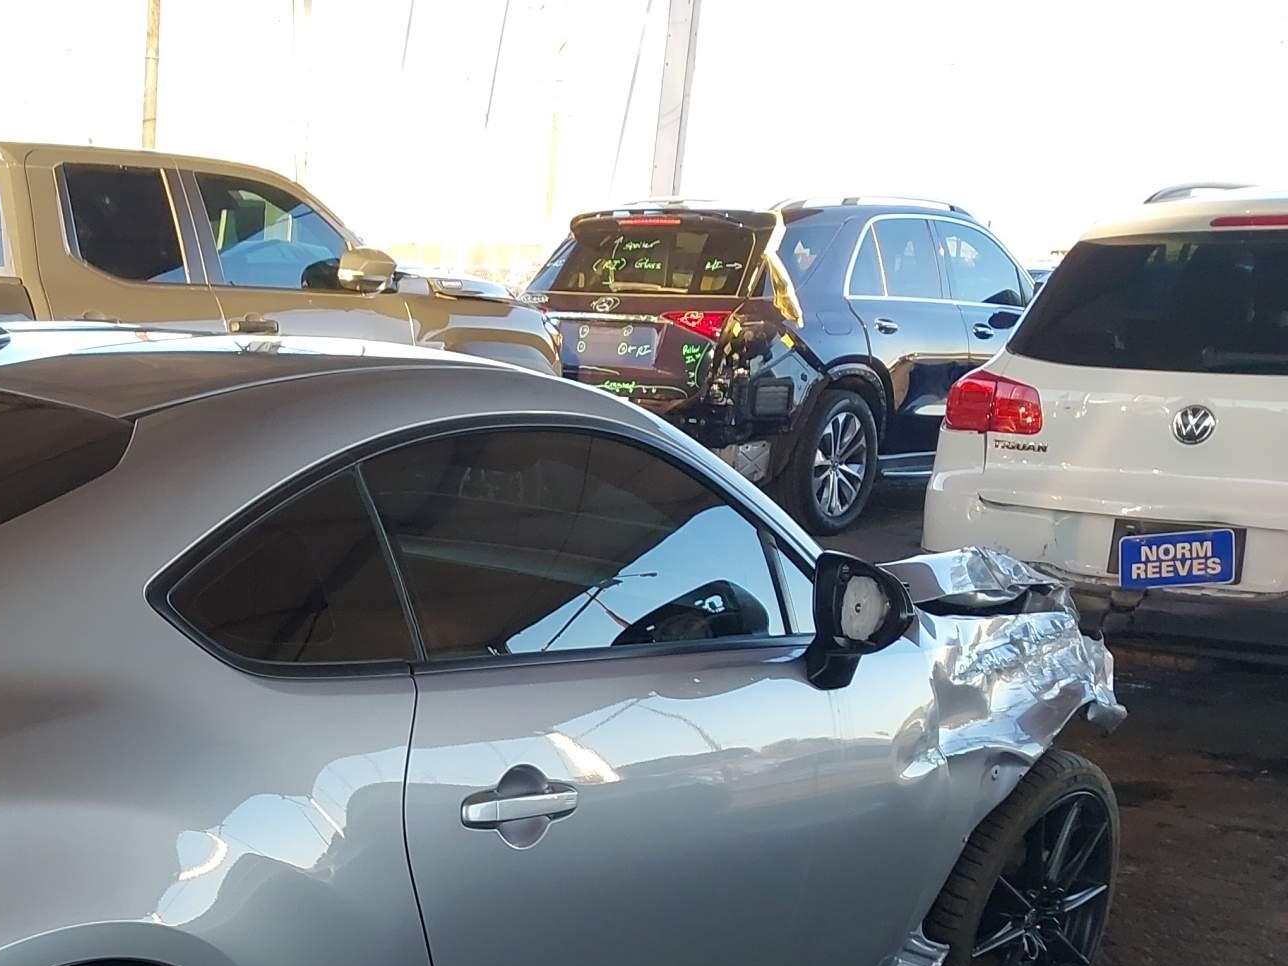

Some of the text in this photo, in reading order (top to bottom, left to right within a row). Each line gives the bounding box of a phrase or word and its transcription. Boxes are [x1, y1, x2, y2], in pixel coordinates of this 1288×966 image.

[993, 439, 1048, 453] TIGUAN
[1140, 540, 1212, 562] NORM
[1131, 557, 1222, 580] REEVES
